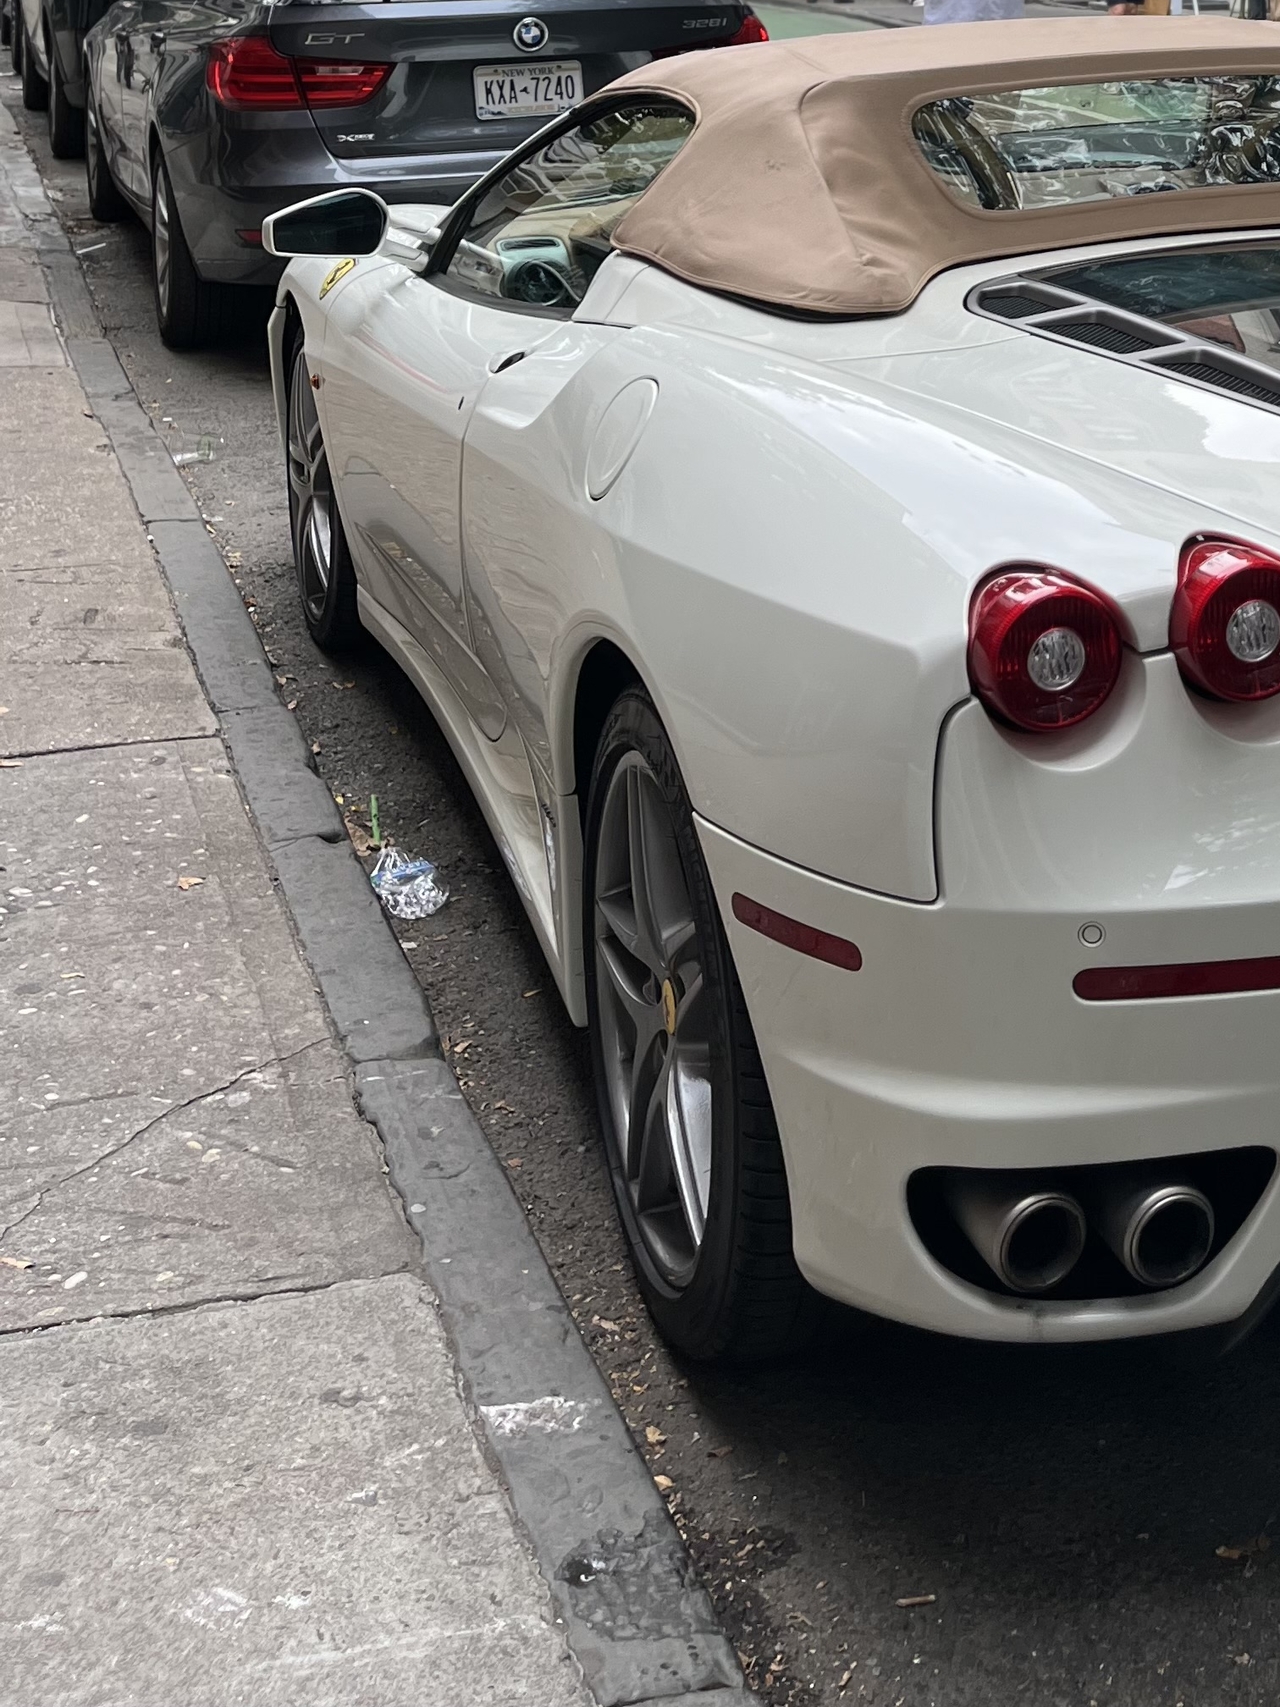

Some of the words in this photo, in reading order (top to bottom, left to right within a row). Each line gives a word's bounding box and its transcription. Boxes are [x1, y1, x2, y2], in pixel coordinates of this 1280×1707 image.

[304, 32, 366, 45] GT
[502, 68, 526, 78] NEW
[527, 66, 555, 76] YORK
